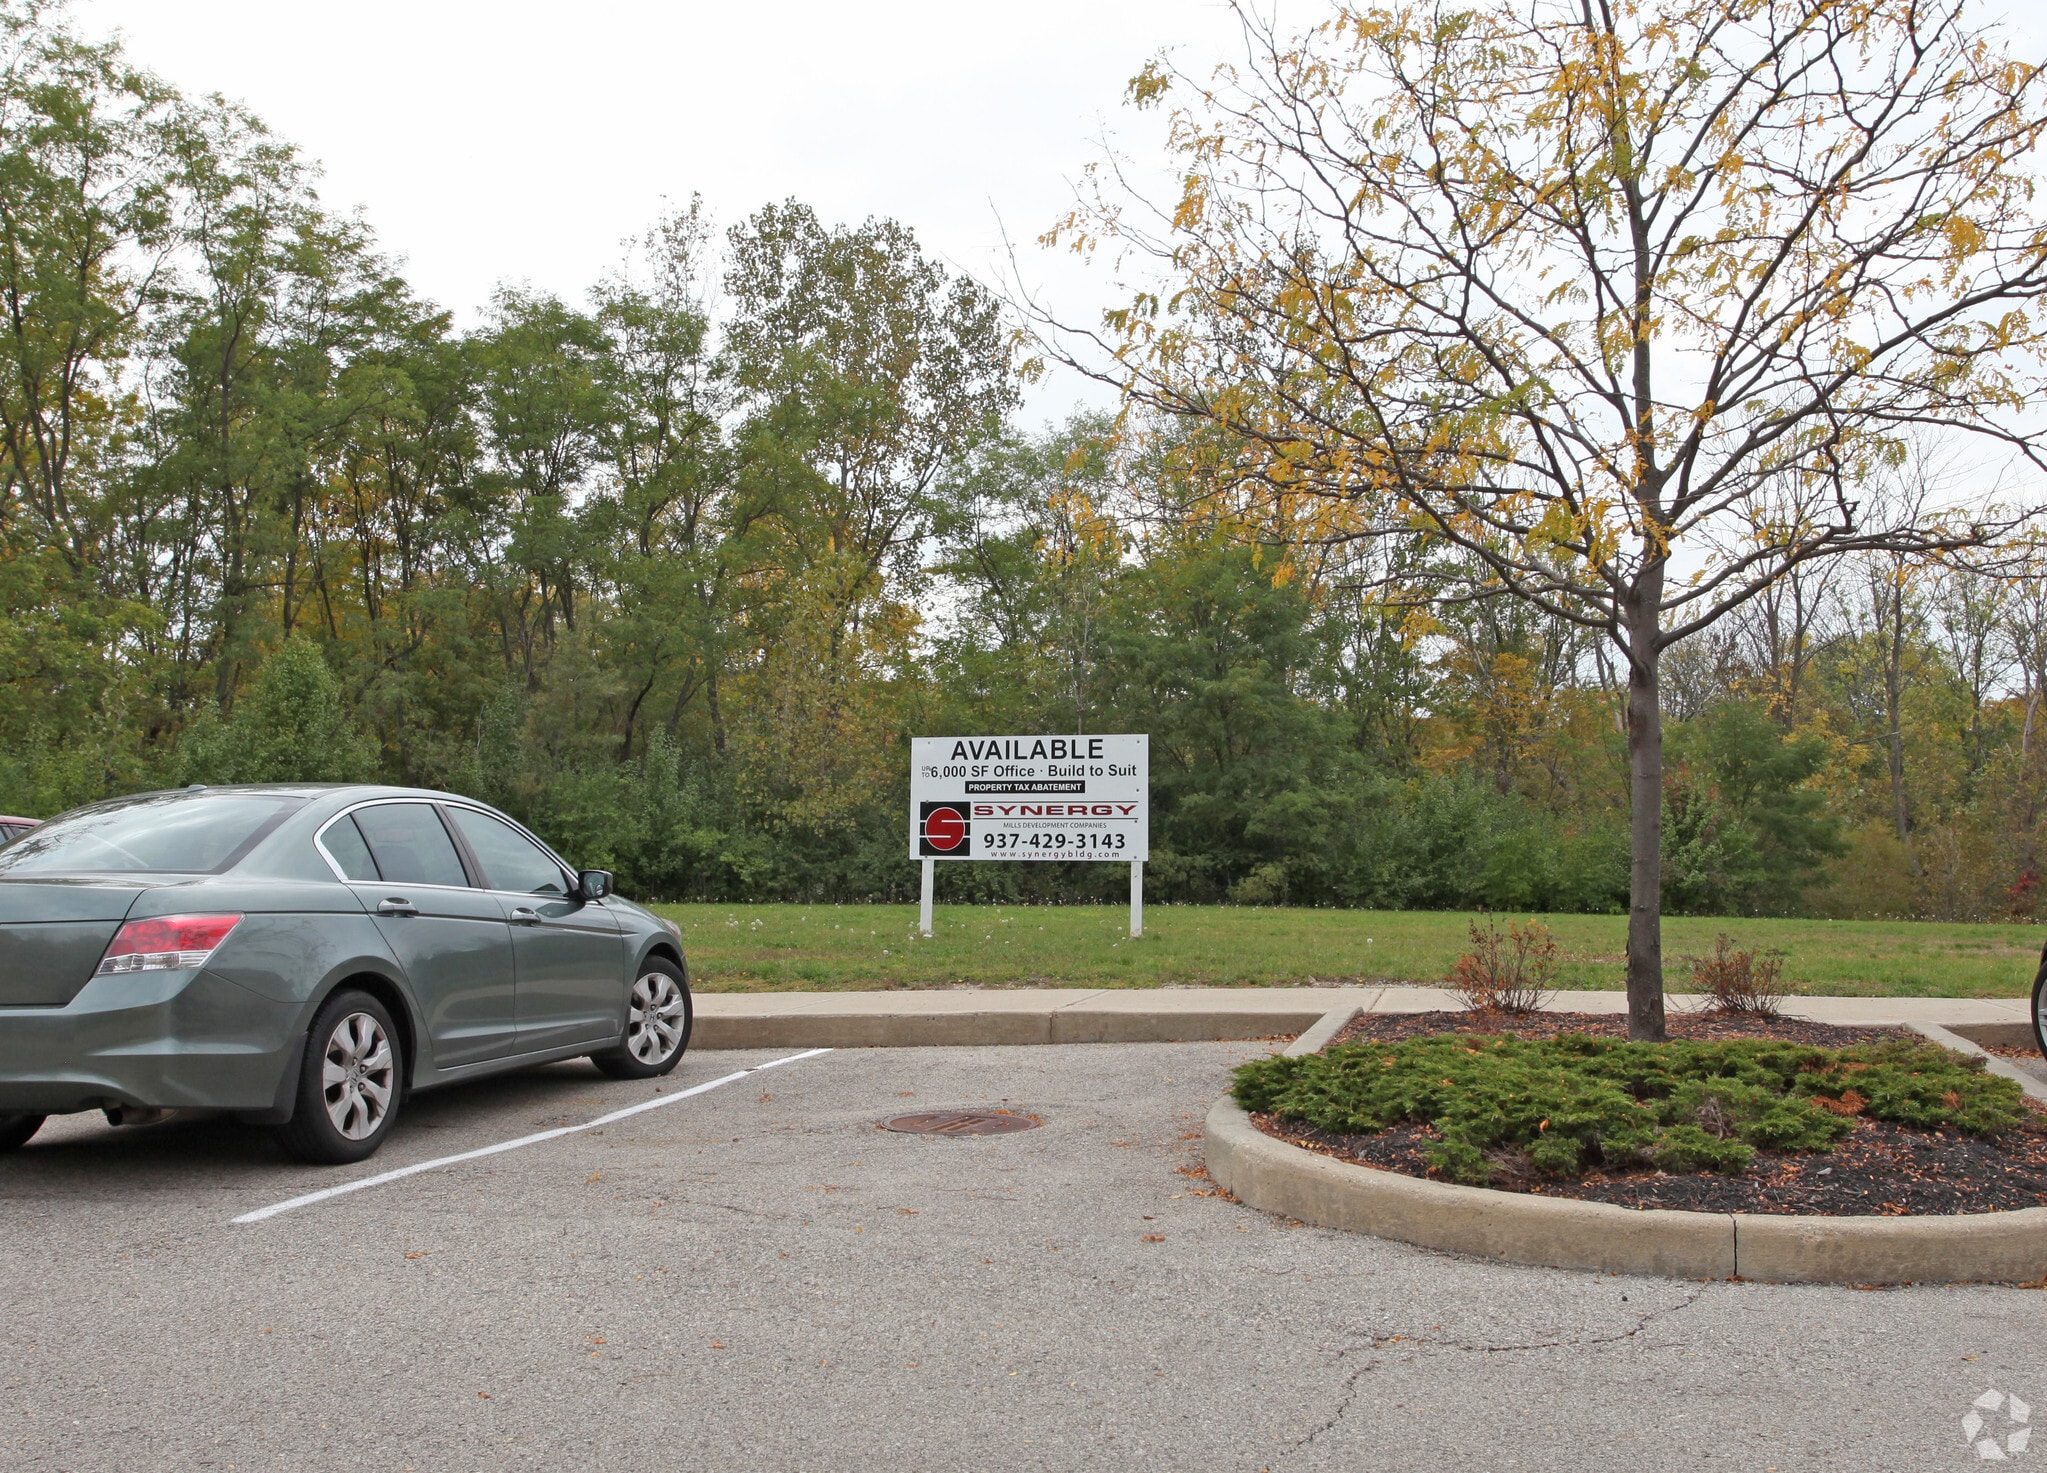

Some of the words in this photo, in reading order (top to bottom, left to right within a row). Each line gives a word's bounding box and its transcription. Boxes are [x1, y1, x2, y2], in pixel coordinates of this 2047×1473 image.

[951, 739, 1103, 760] AVAILABLE
[931, 766, 966, 779] 6,000
[971, 766, 989, 777] SF
[994, 765, 1035, 777] Office
[1048, 765, 1085, 776] Build
[1090, 765, 1103, 776] to
[1108, 764, 1137, 776] Suit
[968, 783, 1012, 791] PROPERTY
[1014, 783, 1029, 791] TAX
[1031, 783, 1082, 791] ABATEMENT
[974, 805, 1137, 816] SYNERGY
[983, 833, 1126, 849] 937-429-3143
[991, 851, 1120, 859] www.synergybldg.com
